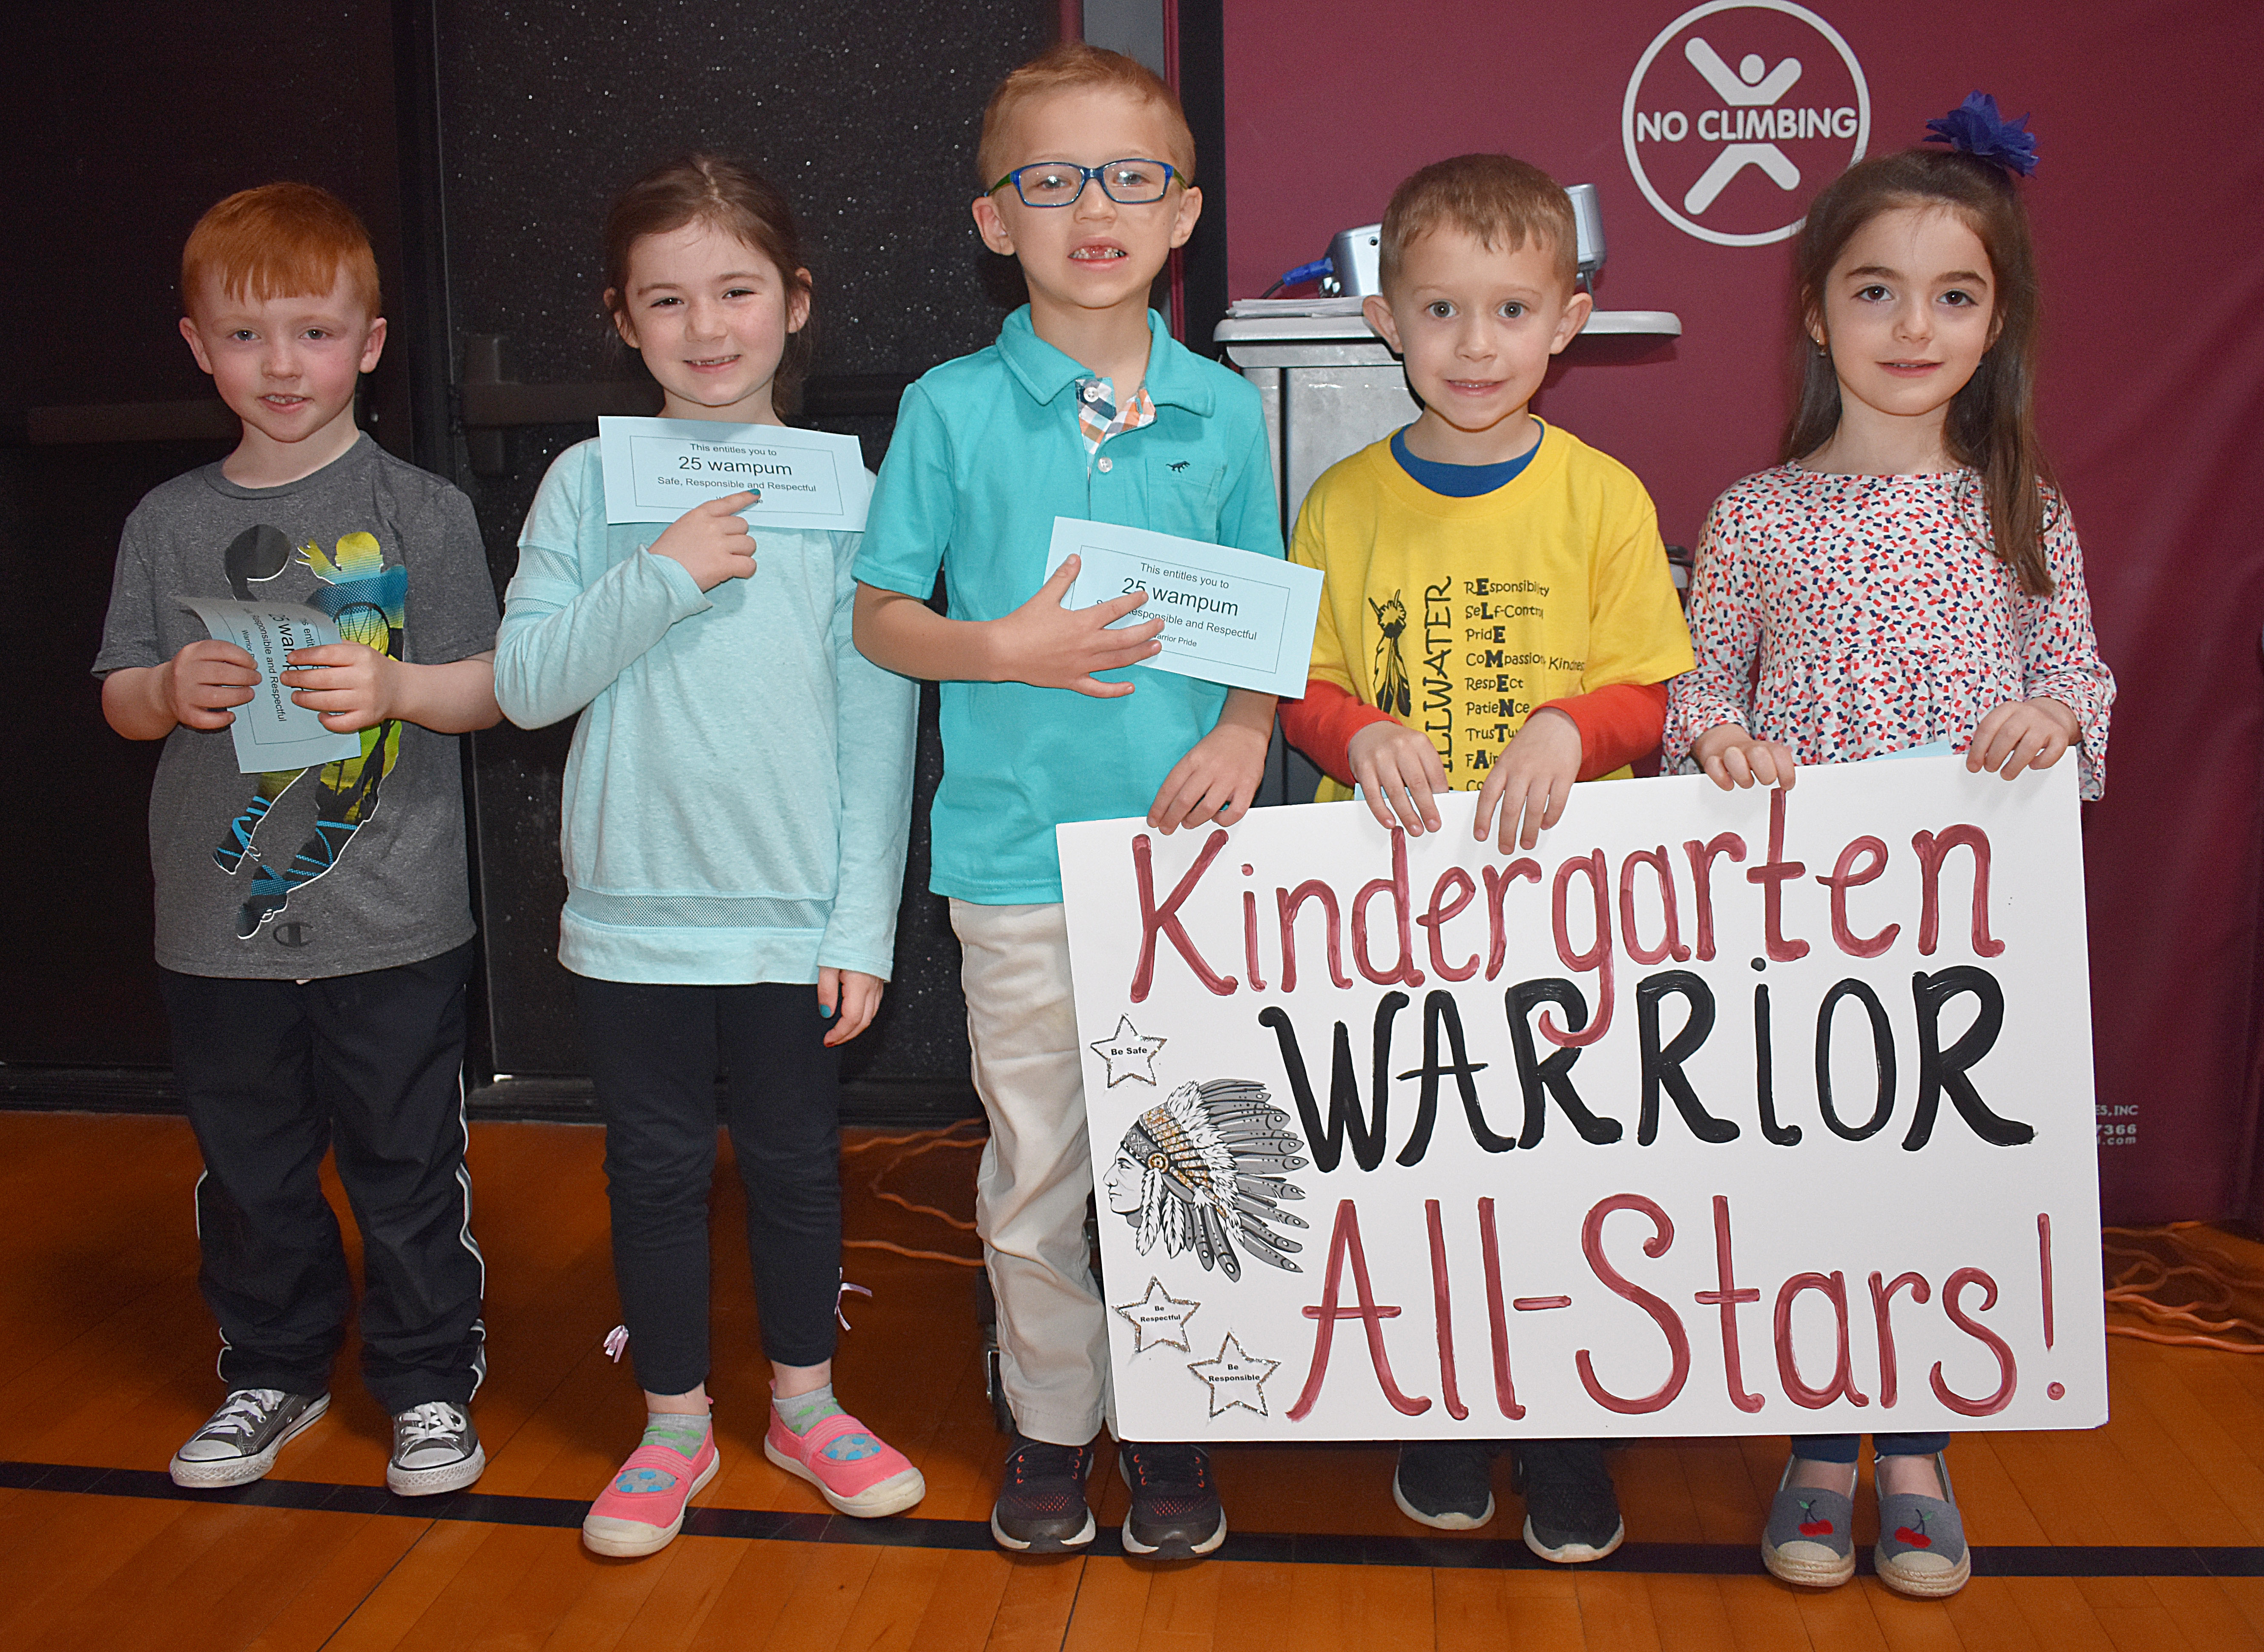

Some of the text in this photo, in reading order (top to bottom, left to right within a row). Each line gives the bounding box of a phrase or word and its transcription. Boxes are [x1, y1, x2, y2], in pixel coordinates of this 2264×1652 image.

[1637, 107, 1857, 142] NO CLIMBING
[690, 443, 710, 452] This
[713, 446, 746, 454] entitles
[679, 456, 792, 476] 25 wampum
[658, 477, 682, 486] Safe,
[686, 478, 744, 488] Responsible
[768, 482, 816, 492] Respectful
[1141, 562, 1230, 588] This entitles you to
[1121, 577, 1238, 616] 25 wampum
[1129, 609, 1257, 640] esponsible and Respectful
[1465, 625, 1506, 643] PridE
[241, 629, 252, 652] Warrior
[1178, 637, 1197, 647] Pride
[267, 657, 277, 674] and
[270, 676, 287, 722] Respectful
[1130, 787, 2006, 1047] Kindergarten
[1140, 1314, 1181, 1322] Respectful
[1285, 1193, 2066, 1421] All-Stars!
